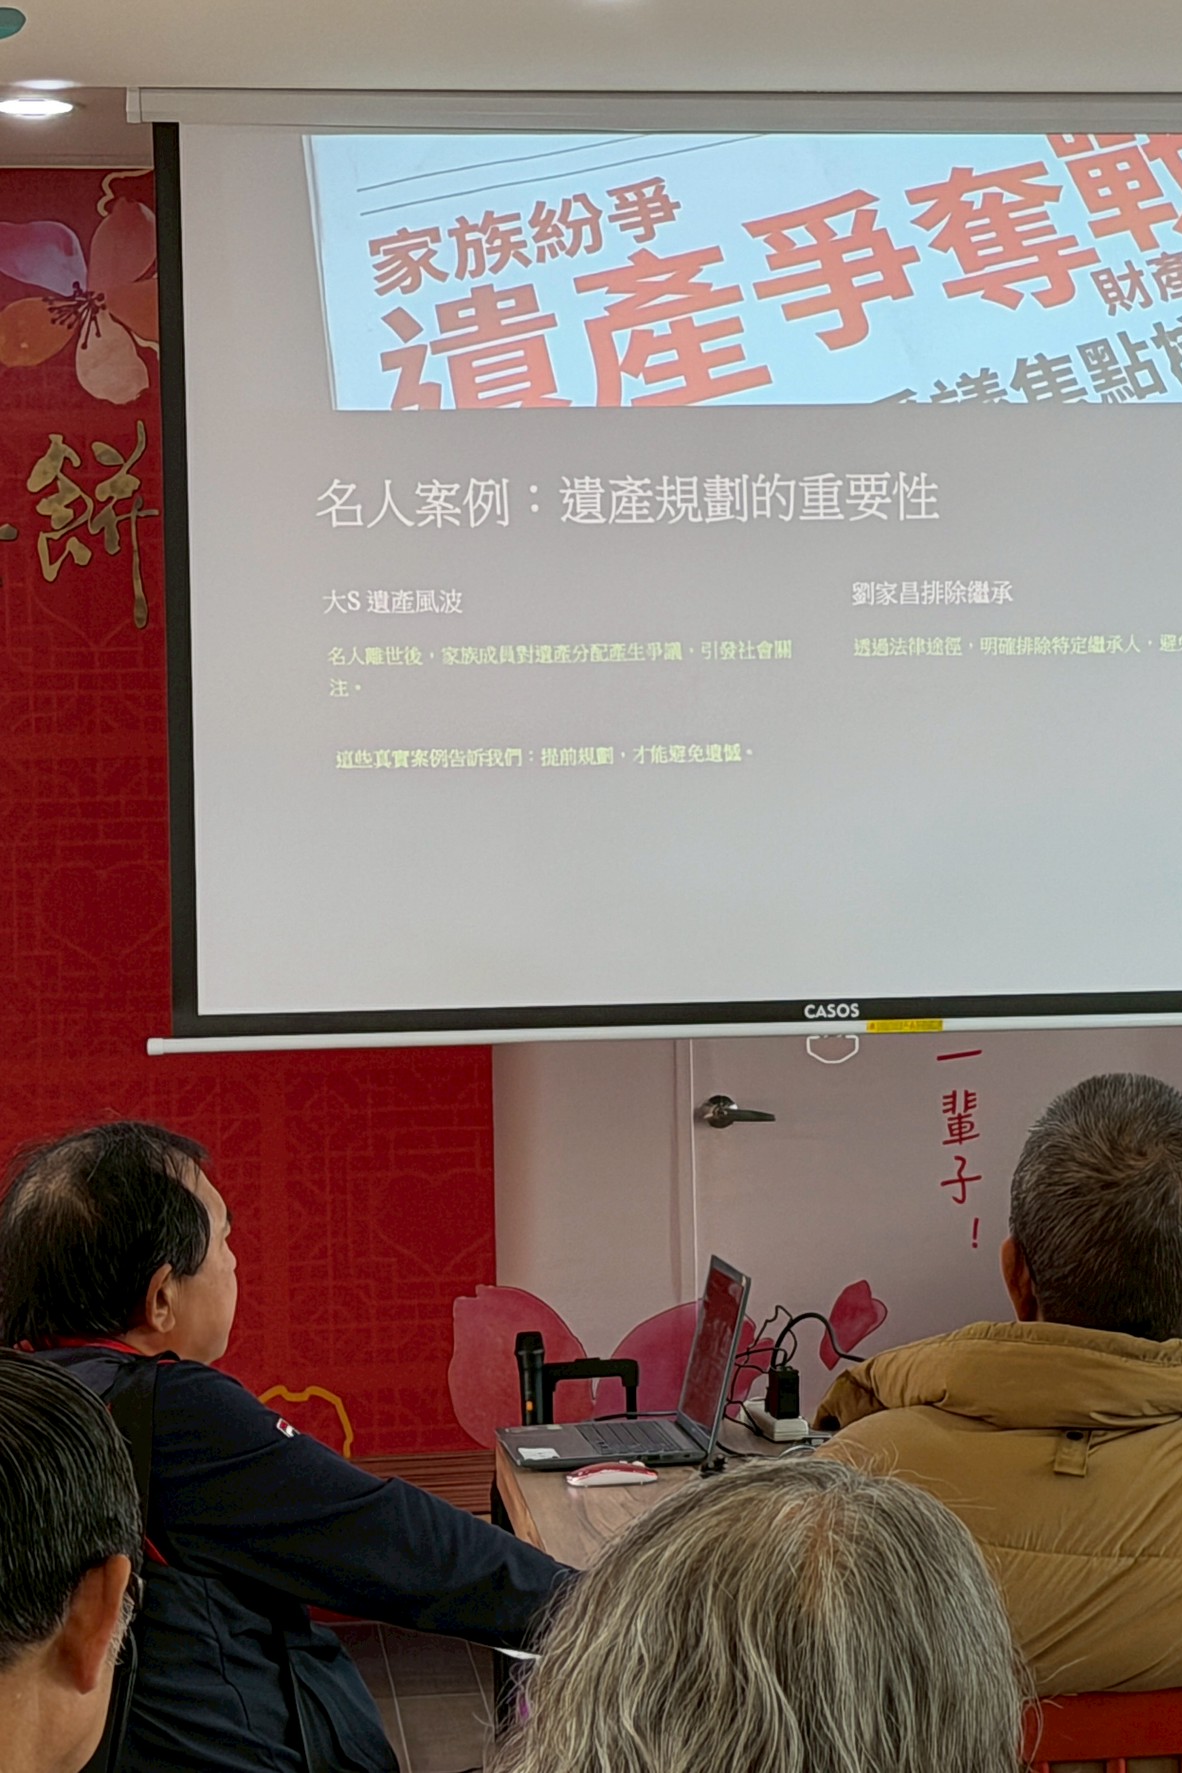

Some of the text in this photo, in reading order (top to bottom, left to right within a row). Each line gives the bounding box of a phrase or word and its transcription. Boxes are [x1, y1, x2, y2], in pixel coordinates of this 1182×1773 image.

[368, 177, 681, 296] 家族紛爭
[315, 471, 941, 529] 名人案例：遺產規劃的重要性
[322, 588, 464, 616] 大S 遺產風波
[851, 580, 1014, 606] 劉家昌排除繼承
[328, 678, 363, 698] 注。
[804, 1003, 860, 1018] CASOS
